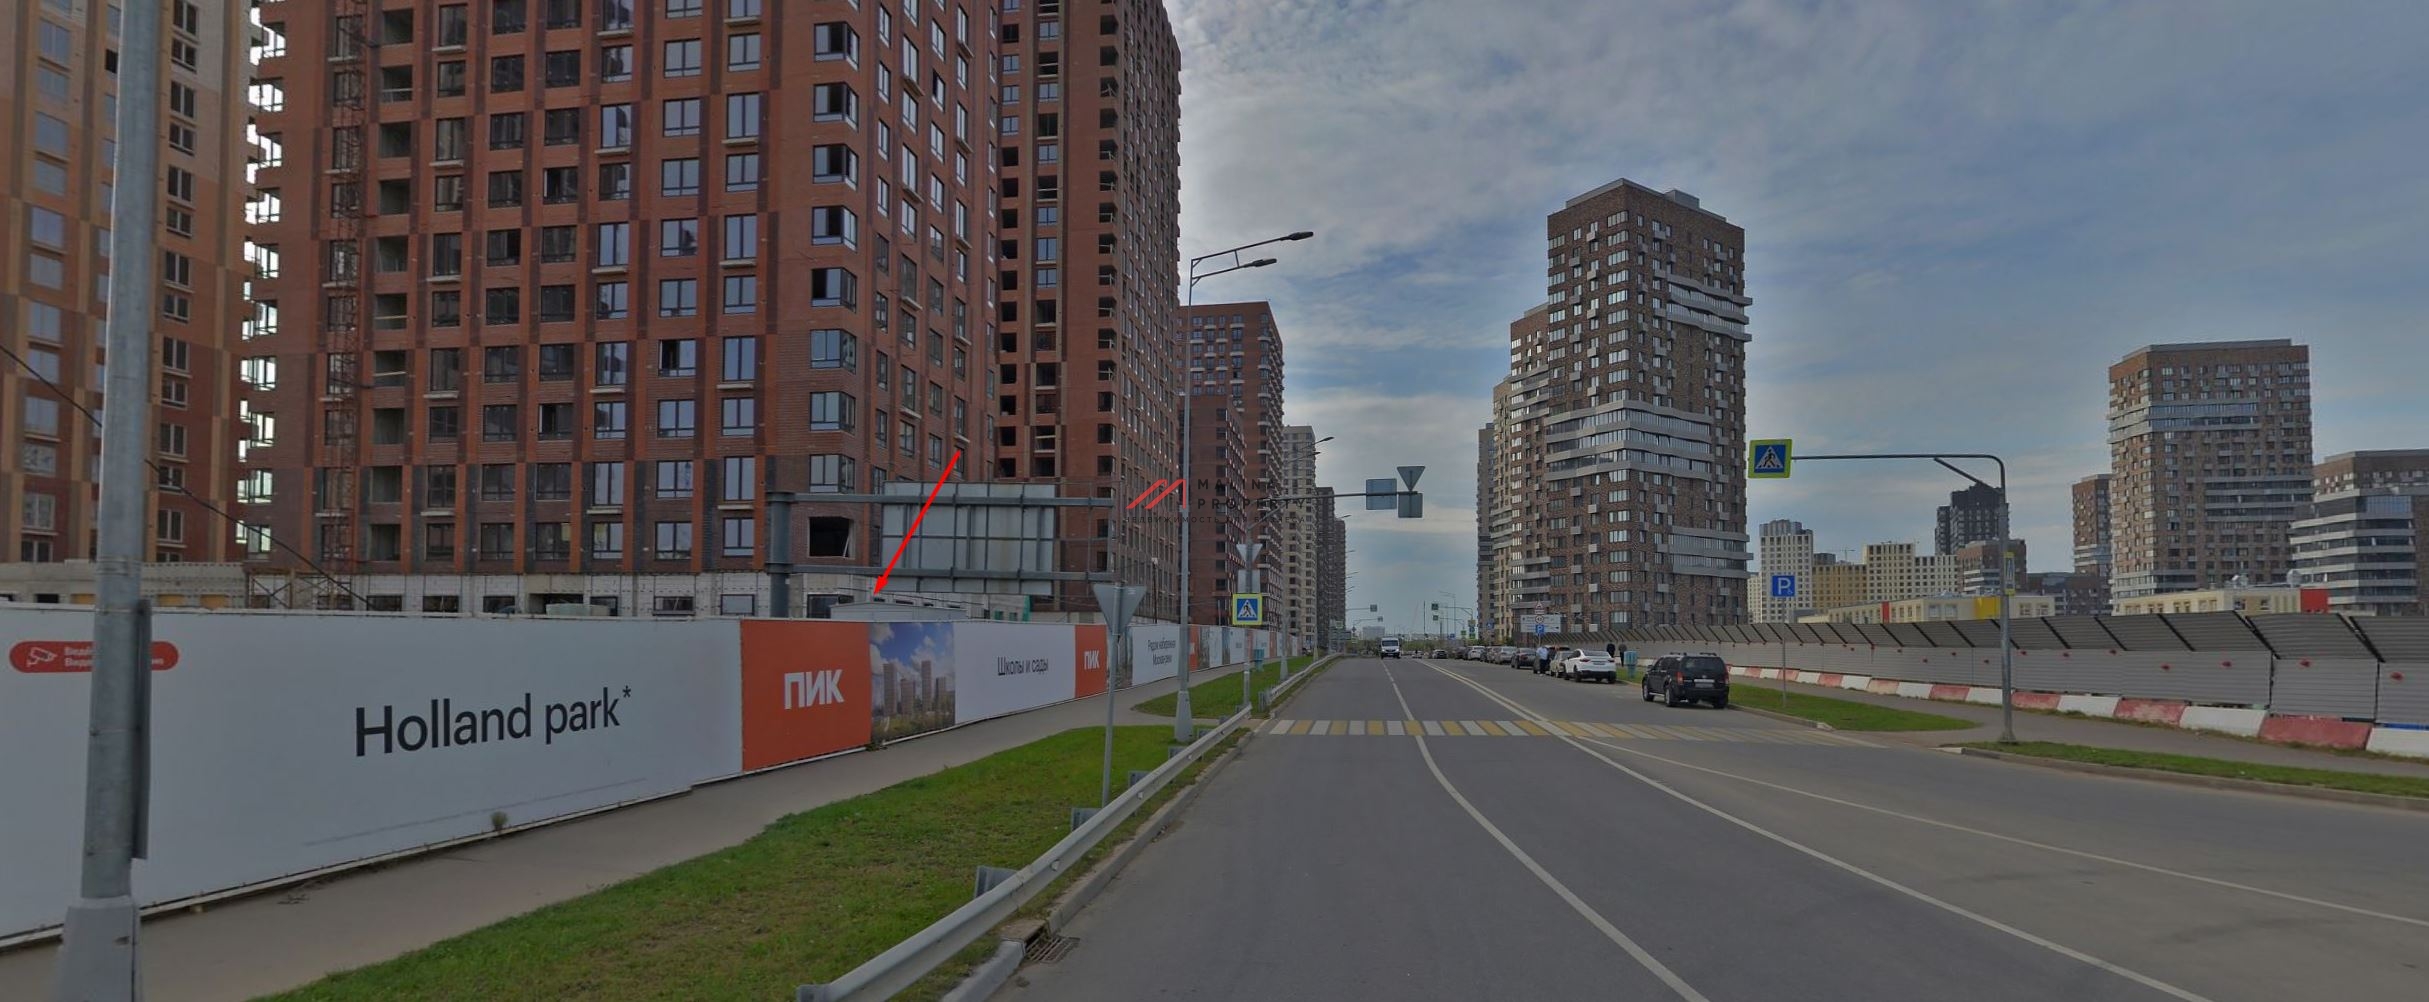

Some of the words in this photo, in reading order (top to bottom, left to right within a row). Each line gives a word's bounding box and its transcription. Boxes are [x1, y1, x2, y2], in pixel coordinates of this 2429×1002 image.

[1777, 577, 1791, 595] P
[997, 656, 1025, 676] Школы
[1032, 658, 1049, 675] сады
[1083, 649, 1100, 671] ПИК
[784, 669, 846, 710] ПИК
[356, 692, 532, 757] Holland
